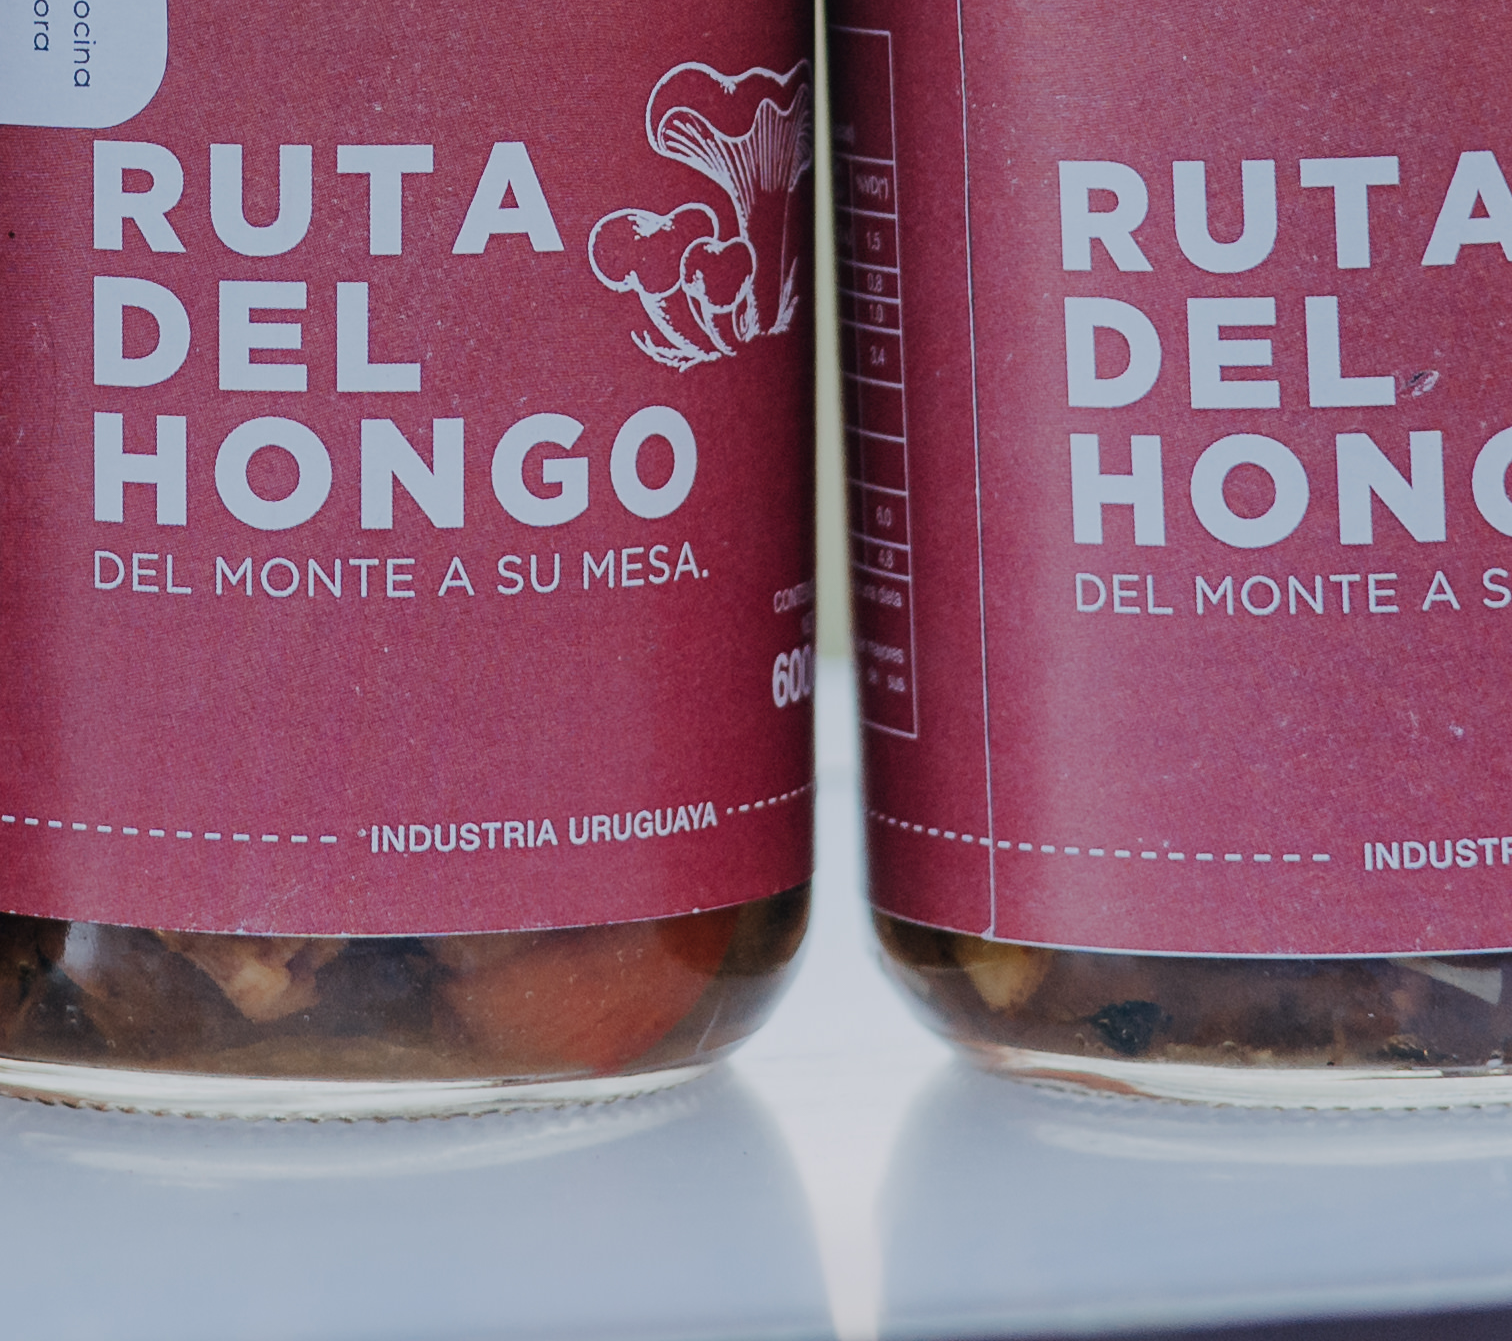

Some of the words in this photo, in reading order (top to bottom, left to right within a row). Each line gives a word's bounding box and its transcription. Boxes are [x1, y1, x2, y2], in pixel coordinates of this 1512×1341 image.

[94, 140, 564, 256] RUTA
[94, 276, 421, 392] DEL
[1064, 296, 1395, 409] DEL
[94, 406, 697, 530] HONGO
[95, 551, 192, 594] DEL
[216, 557, 415, 597] MONTE
[438, 557, 474, 596] A
[498, 554, 560, 595] SU
[583, 542, 708, 590] MESA.
[1076, 573, 1173, 614] DEL
[1196, 573, 1399, 615] MONTE
[1422, 571, 1460, 610] A
[772, 644, 815, 708] 600
[372, 819, 558, 853] INDUSTRIA
[569, 802, 717, 845] URUGUAYA
